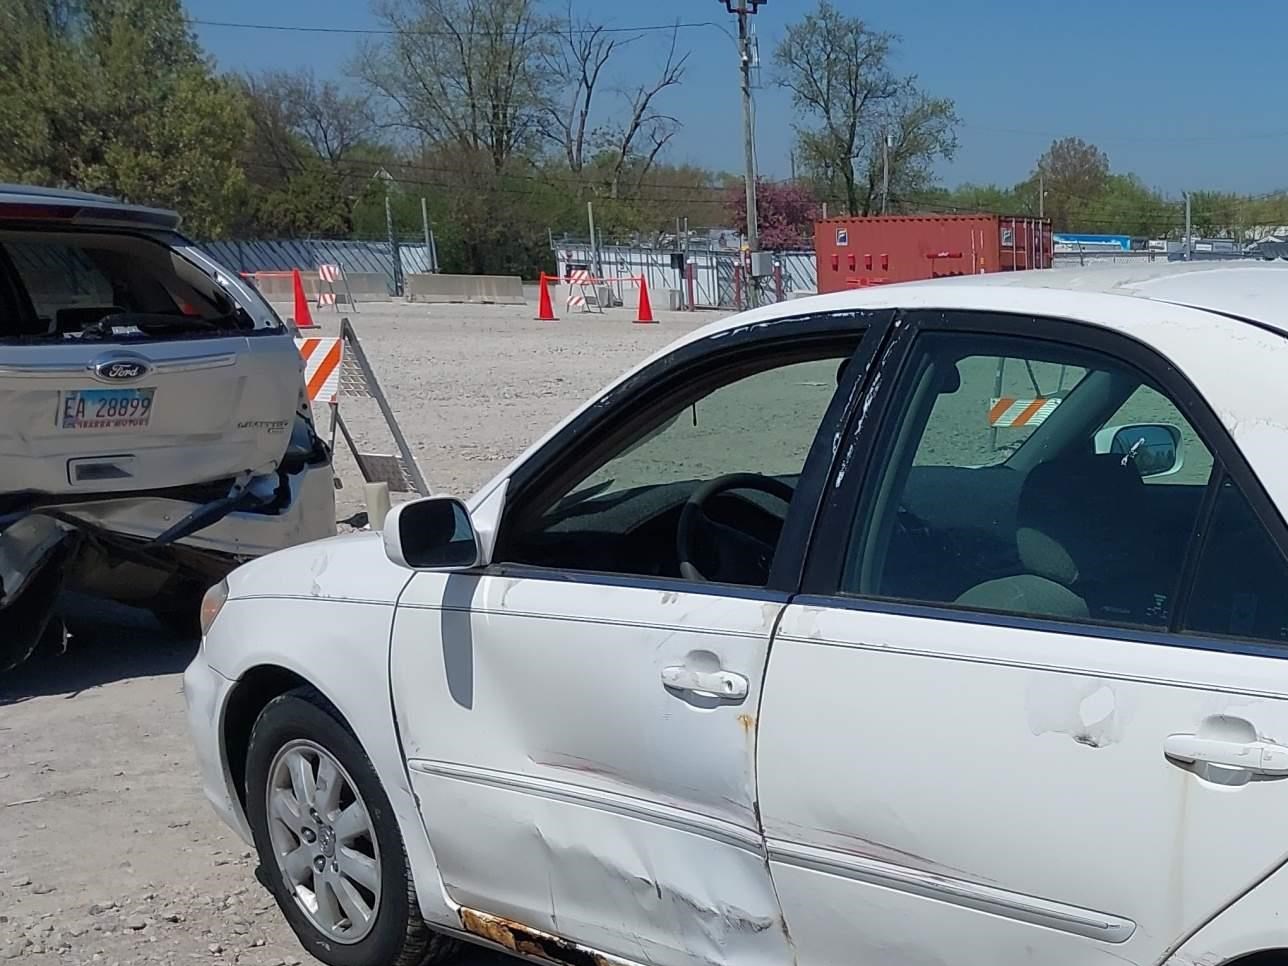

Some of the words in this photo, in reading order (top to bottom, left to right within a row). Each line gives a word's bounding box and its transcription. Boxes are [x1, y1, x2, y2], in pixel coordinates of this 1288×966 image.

[108, 364, 139, 377] Ford
[64, 397, 85, 418] EA
[95, 397, 151, 418] 28899
